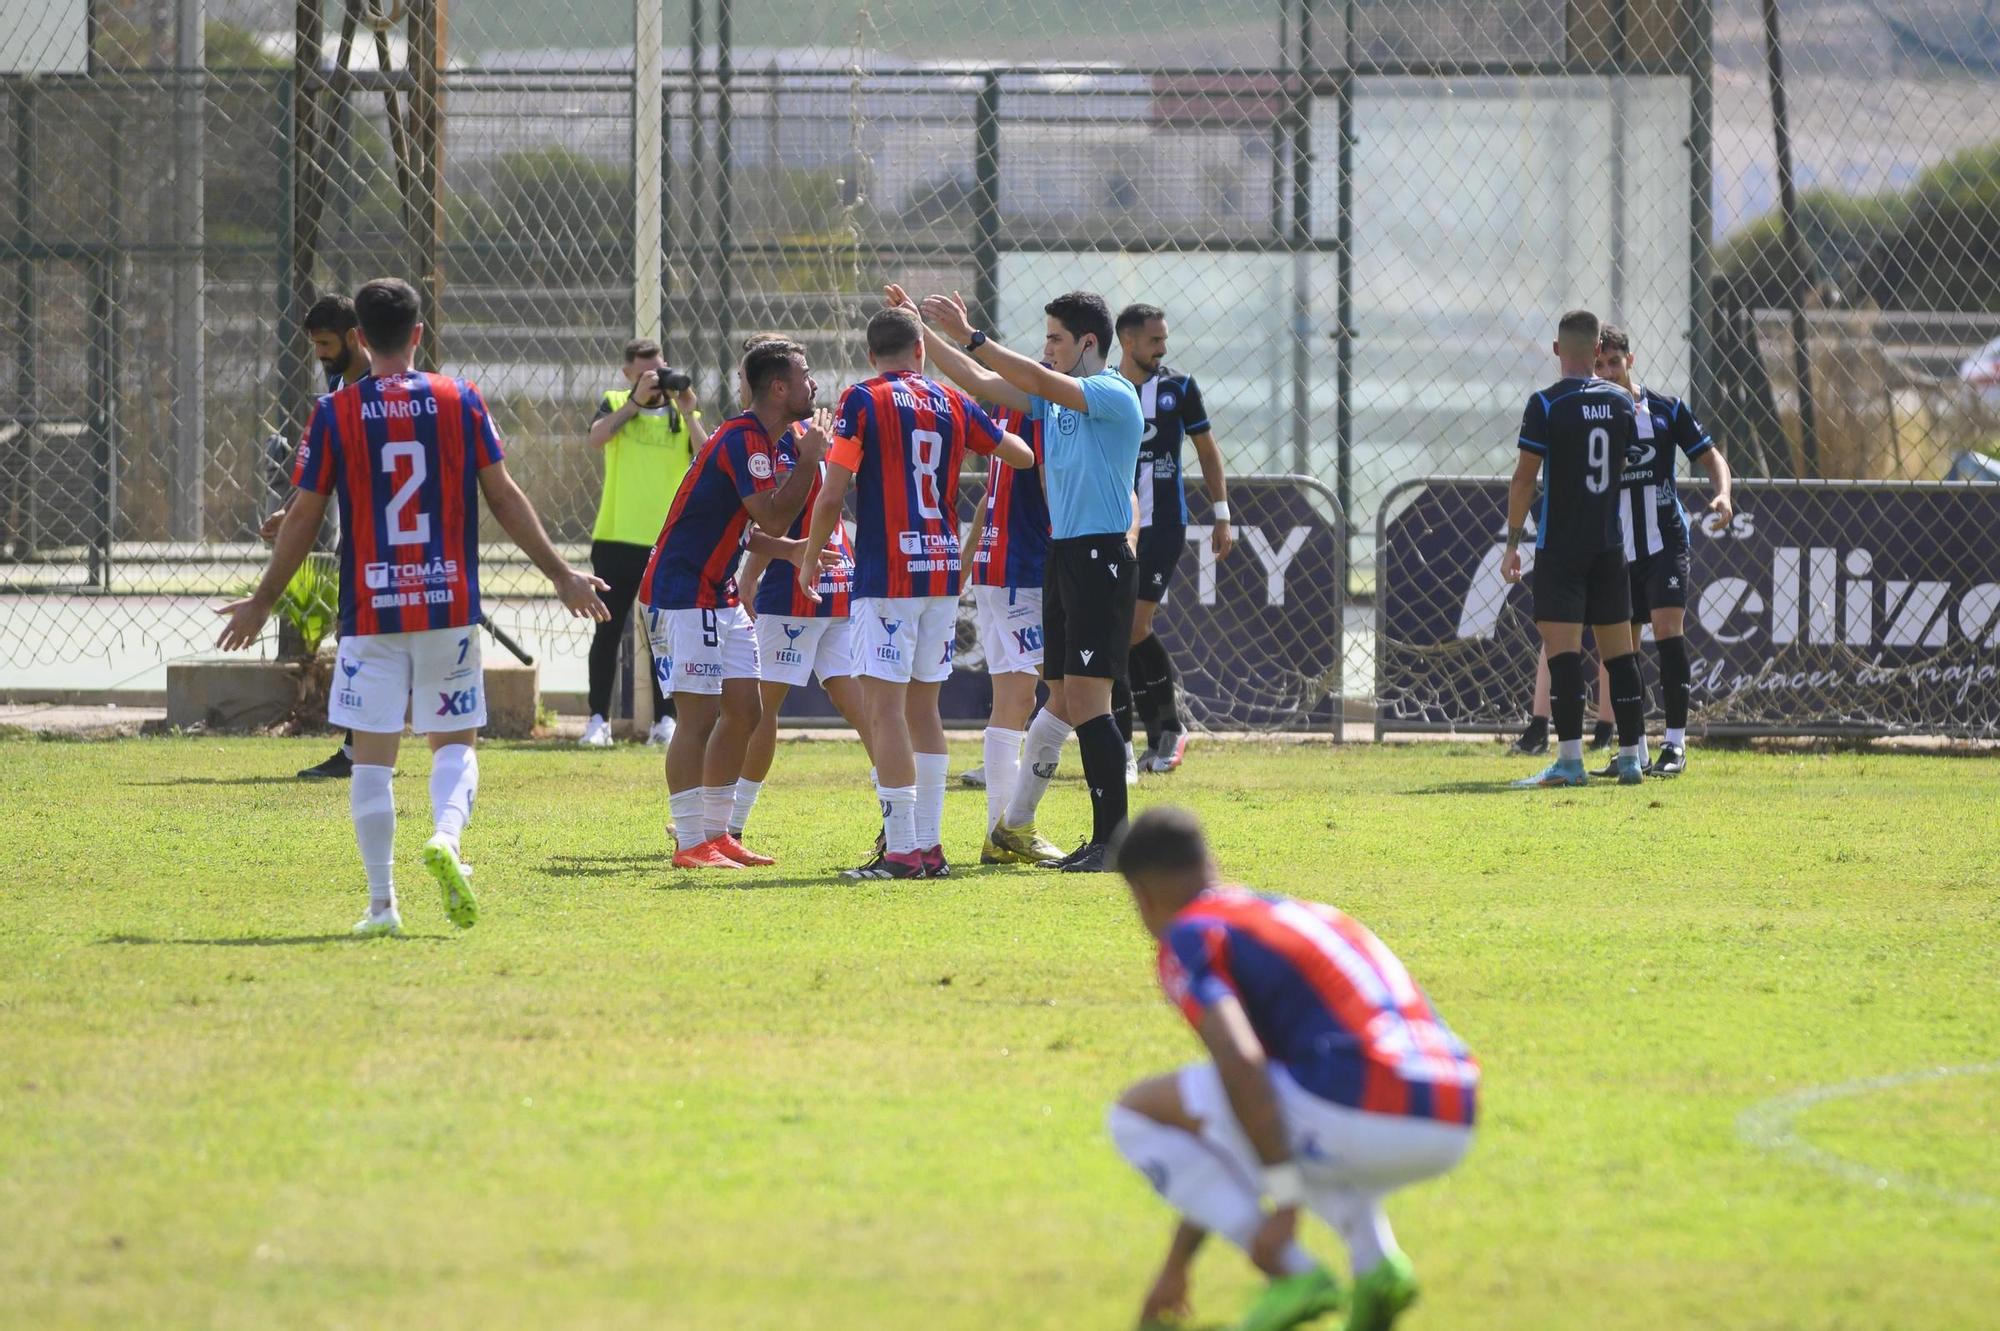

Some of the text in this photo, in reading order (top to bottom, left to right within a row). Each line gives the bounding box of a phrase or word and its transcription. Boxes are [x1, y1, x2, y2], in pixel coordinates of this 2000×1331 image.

[361, 396, 438, 420] ALVARO G
[1582, 404, 1613, 420] RAUL
[911, 429, 943, 519] 8
[1585, 427, 1610, 494] 9
[382, 440, 431, 546] 2
[907, 560, 935, 573] CIUDAD
[936, 559, 945, 571] DE
[1160, 525, 1313, 606] TY
[372, 589, 455, 609] CIUDAD DE YECLA
[702, 607, 718, 648] 9
[1012, 624, 1045, 655] Xti
[776, 650, 802, 663] YECLA
[436, 686, 477, 716] Xti
